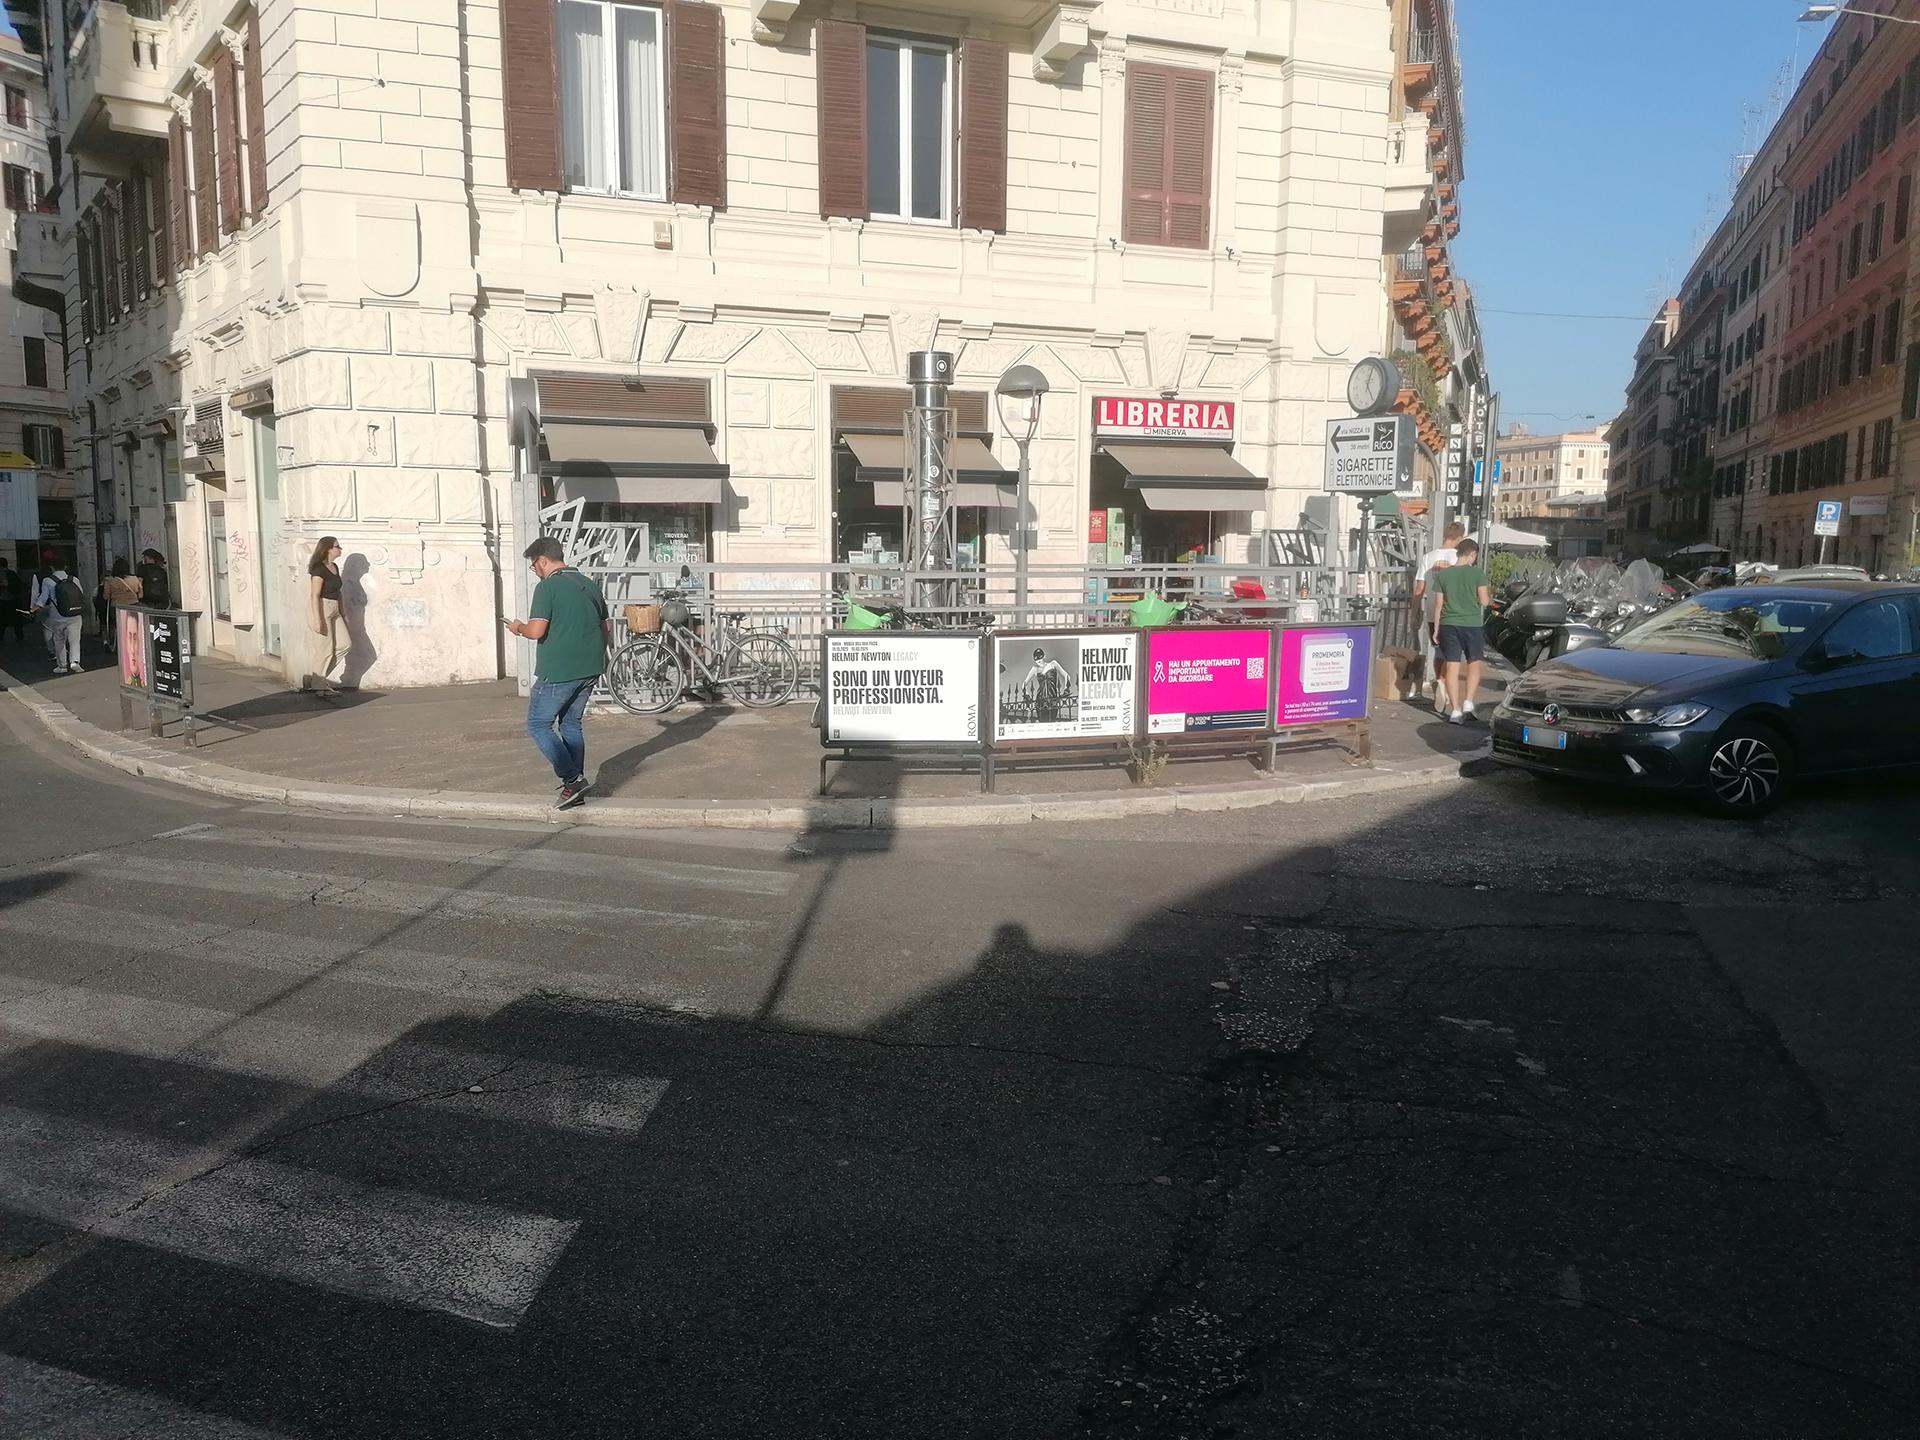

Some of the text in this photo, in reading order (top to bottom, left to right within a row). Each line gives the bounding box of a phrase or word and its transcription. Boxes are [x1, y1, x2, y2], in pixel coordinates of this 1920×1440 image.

[1100, 400, 1230, 429] LIBRERIA
[1152, 428, 1187, 436] MINERVA
[1349, 426, 1364, 434] NIZZA
[1374, 440, 1394, 450] RICO
[1336, 457, 1394, 472] SIGARETTE
[1336, 473, 1393, 486] ELETTRONICHE
[1446, 438, 1461, 507] SAVOY
[831, 650, 919, 662] HELMUT NEWTON LEGACY
[1081, 647, 1128, 664] HELMUT
[1168, 658, 1241, 668] HAI UN APPUNTAMENTO
[832, 669, 944, 687] SONO UN VOYEUR
[1081, 665, 1132, 682] NEWTON
[1168, 667, 1208, 675] IMPORTANTE
[1168, 674, 1214, 683] DA RICORDARE
[832, 687, 944, 705] PROFESSIONISTA.
[1081, 682, 1124, 699] LEGACY
[833, 705, 892, 716] HELMUT NEWTON
[1122, 699, 1131, 731] ROMA
[967, 704, 976, 737] ROMA
